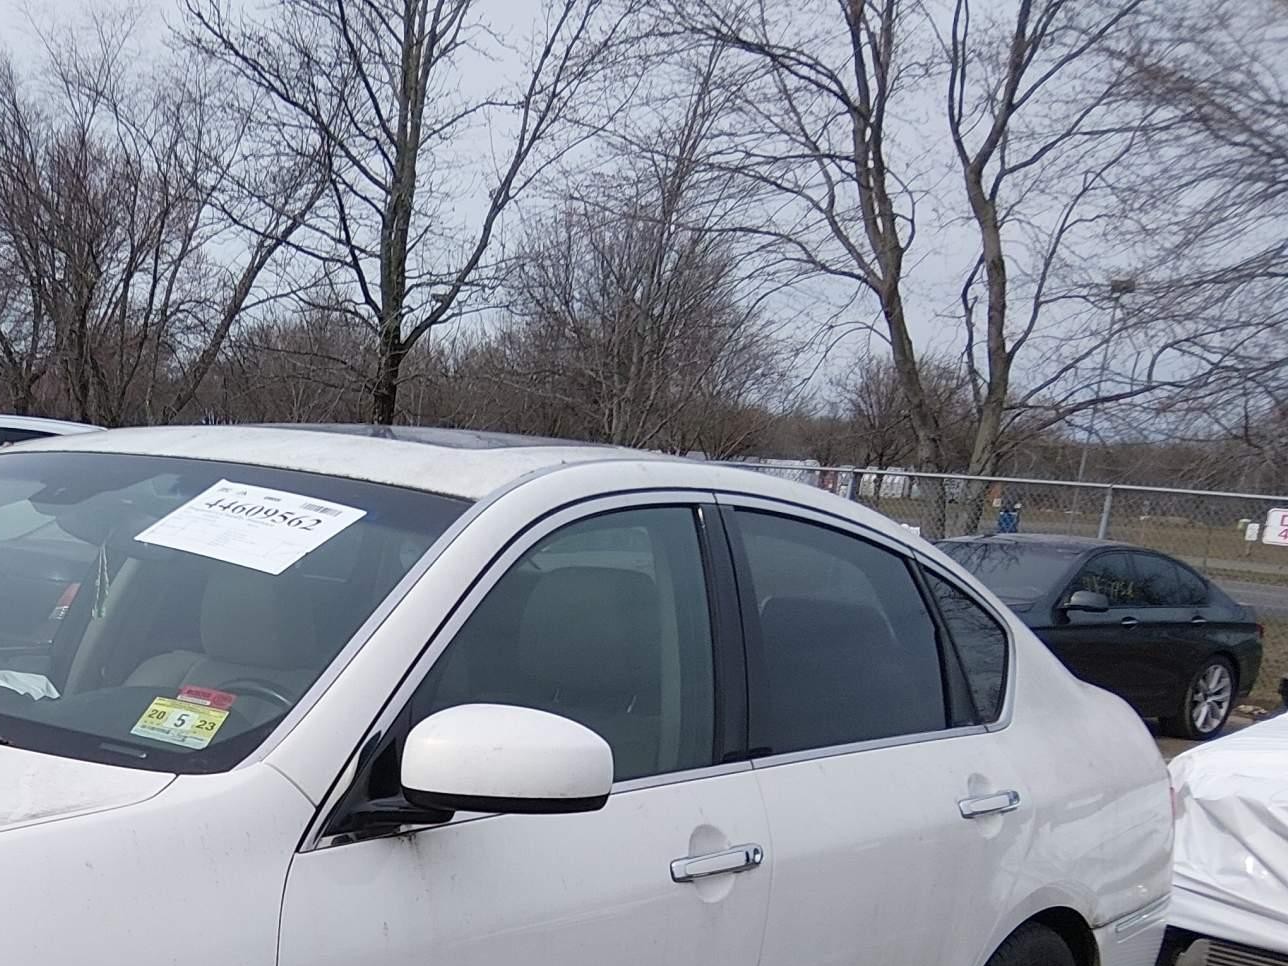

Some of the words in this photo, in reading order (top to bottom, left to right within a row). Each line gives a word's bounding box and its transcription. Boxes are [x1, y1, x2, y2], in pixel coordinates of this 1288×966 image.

[205, 498, 323, 531] 44609562
[147, 708, 166, 721] 20
[174, 713, 189, 728] 5
[195, 719, 216, 732] 23
